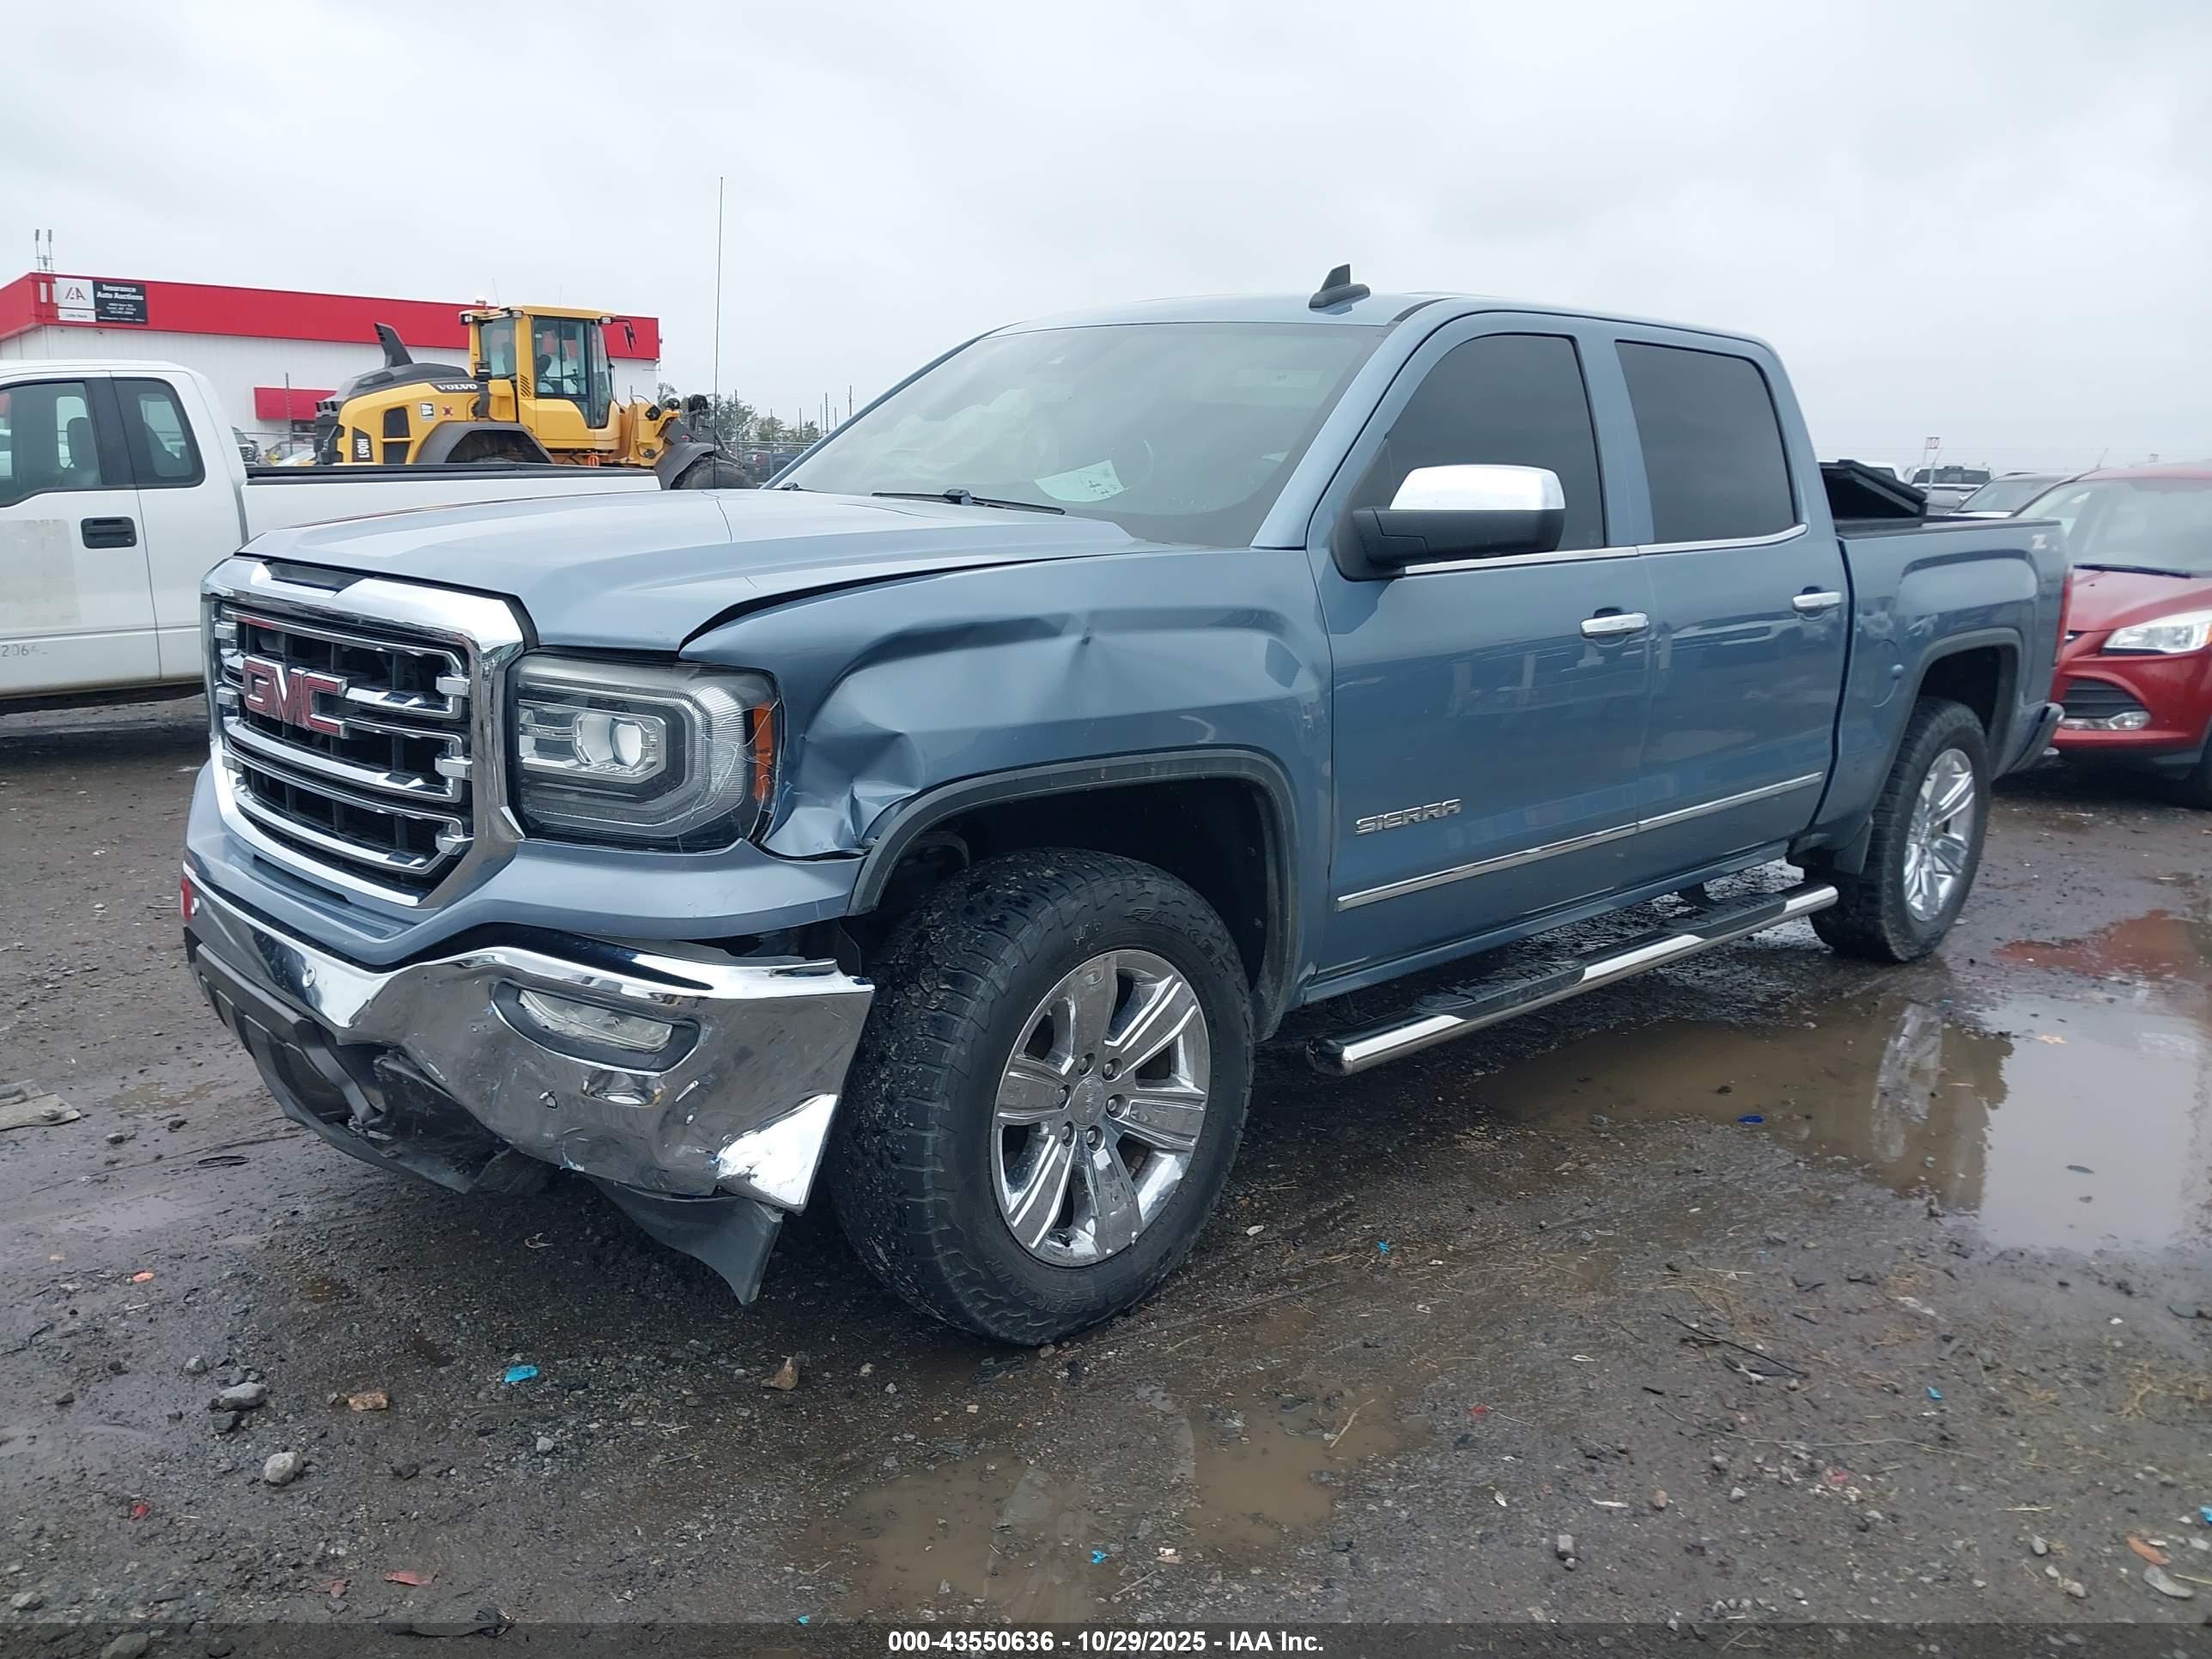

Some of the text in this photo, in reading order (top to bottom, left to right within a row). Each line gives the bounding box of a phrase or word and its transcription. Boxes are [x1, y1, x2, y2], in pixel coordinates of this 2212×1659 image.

[113, 292, 144, 301] Auctions
[356, 438, 370, 459] L90H
[243, 655, 349, 739] GMC
[1354, 798, 1462, 836] SIERRA
